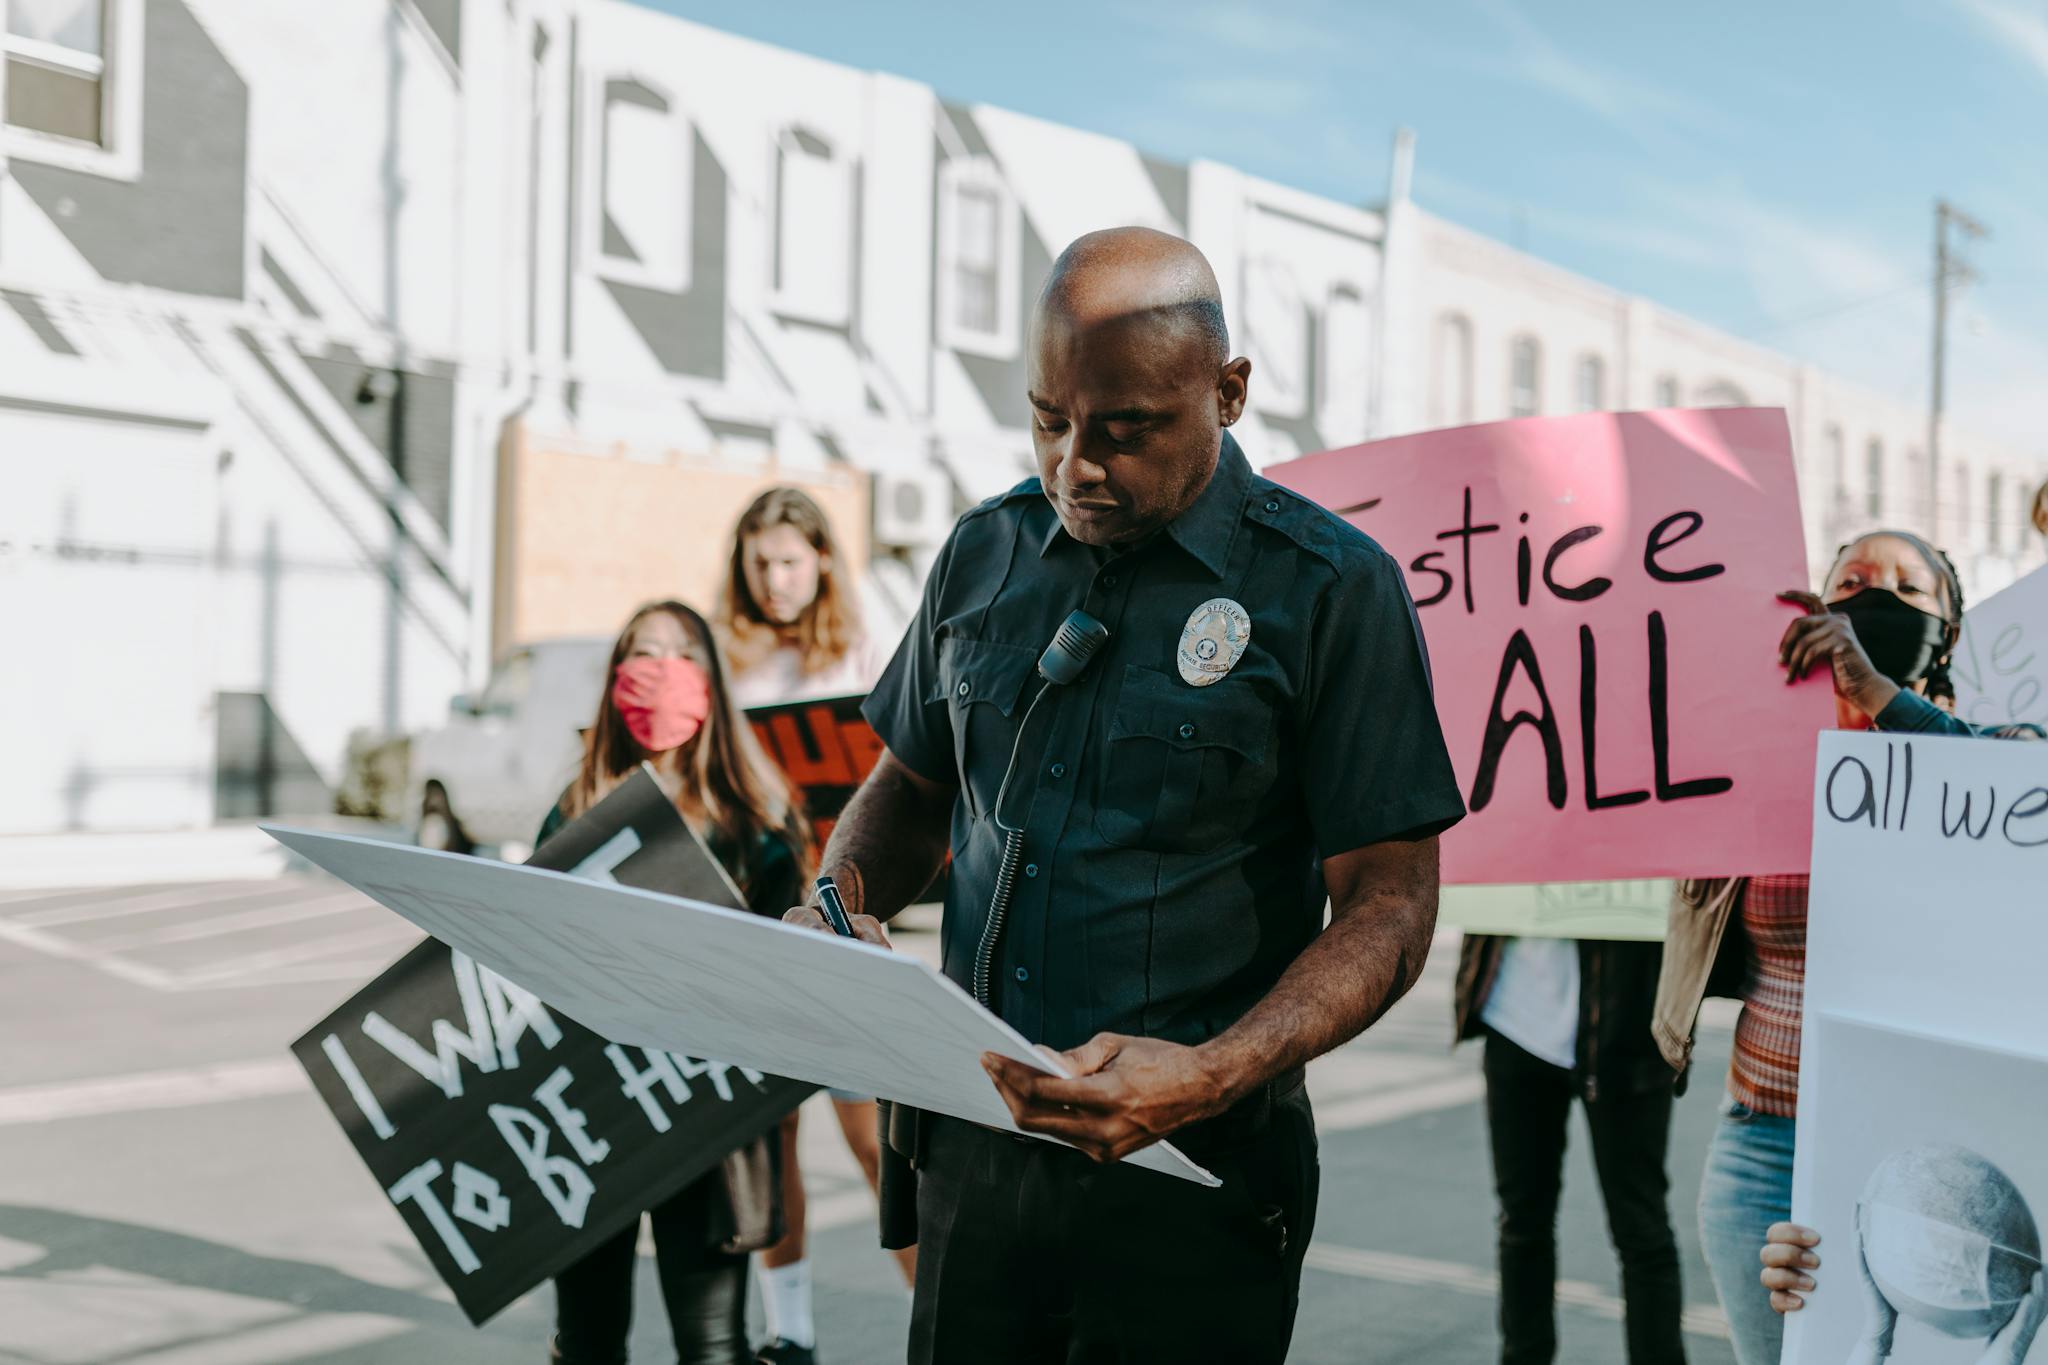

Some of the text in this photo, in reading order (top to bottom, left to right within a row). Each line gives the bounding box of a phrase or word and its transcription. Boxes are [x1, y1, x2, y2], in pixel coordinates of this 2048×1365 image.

[1336, 485, 1726, 613] stice
[1207, 604, 1240, 621] OFFICER
[1469, 610, 1733, 813] ALL
[1826, 742, 1912, 831] all
[321, 1032, 396, 1140] I
[388, 1158, 510, 1274] TO
[488, 1066, 611, 1229] BE
